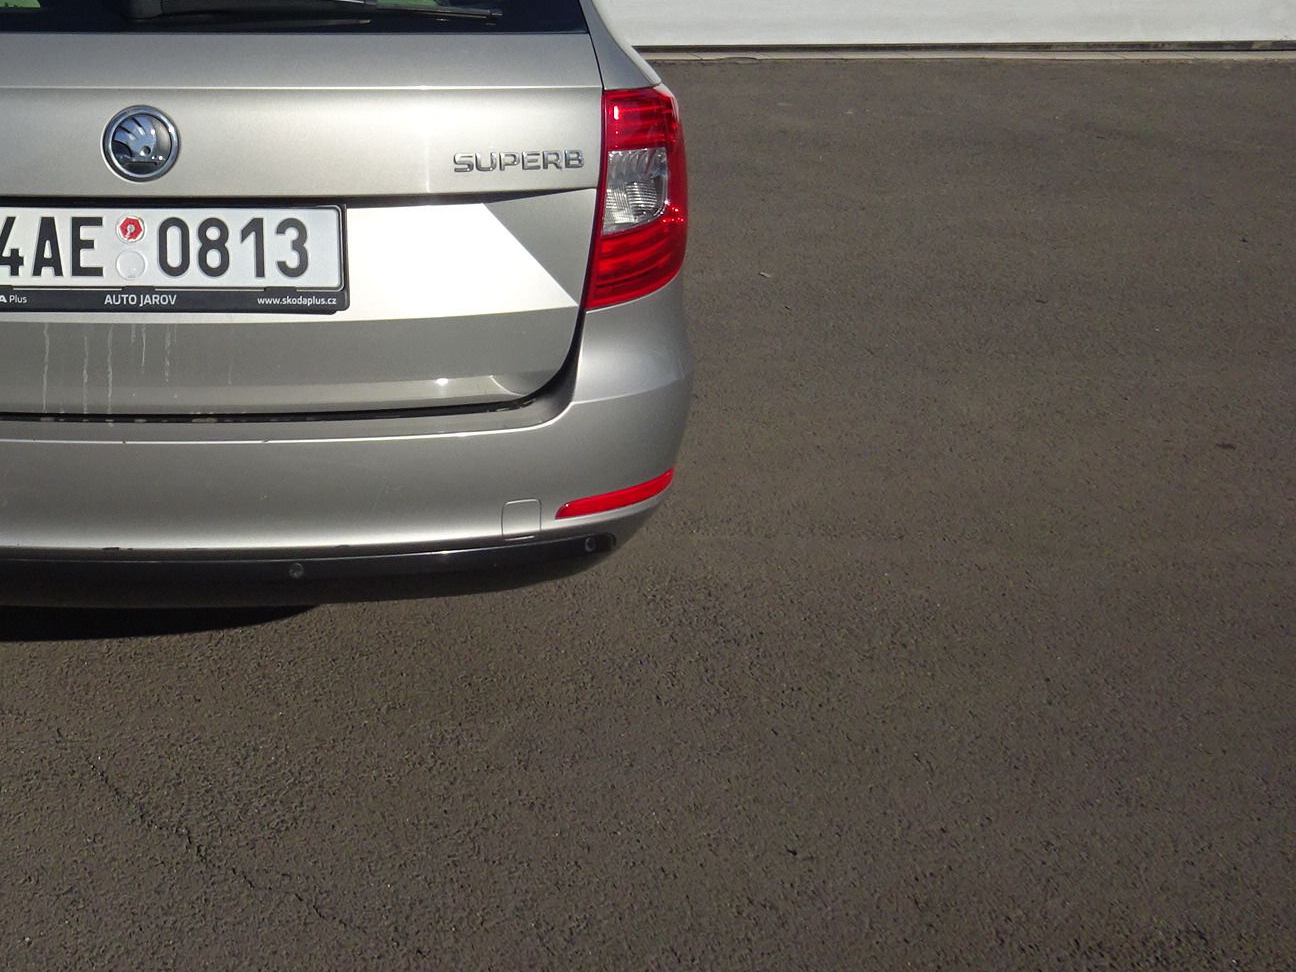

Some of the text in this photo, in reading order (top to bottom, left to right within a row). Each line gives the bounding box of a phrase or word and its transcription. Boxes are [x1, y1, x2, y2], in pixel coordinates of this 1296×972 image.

[454, 149, 585, 173] SUPERB
[157, 216, 309, 278] 0813
[9, 295, 28, 304] Plus
[103, 294, 178, 307] AUTO JAROV
[257, 296, 337, 307] www.skodaplus.cz
